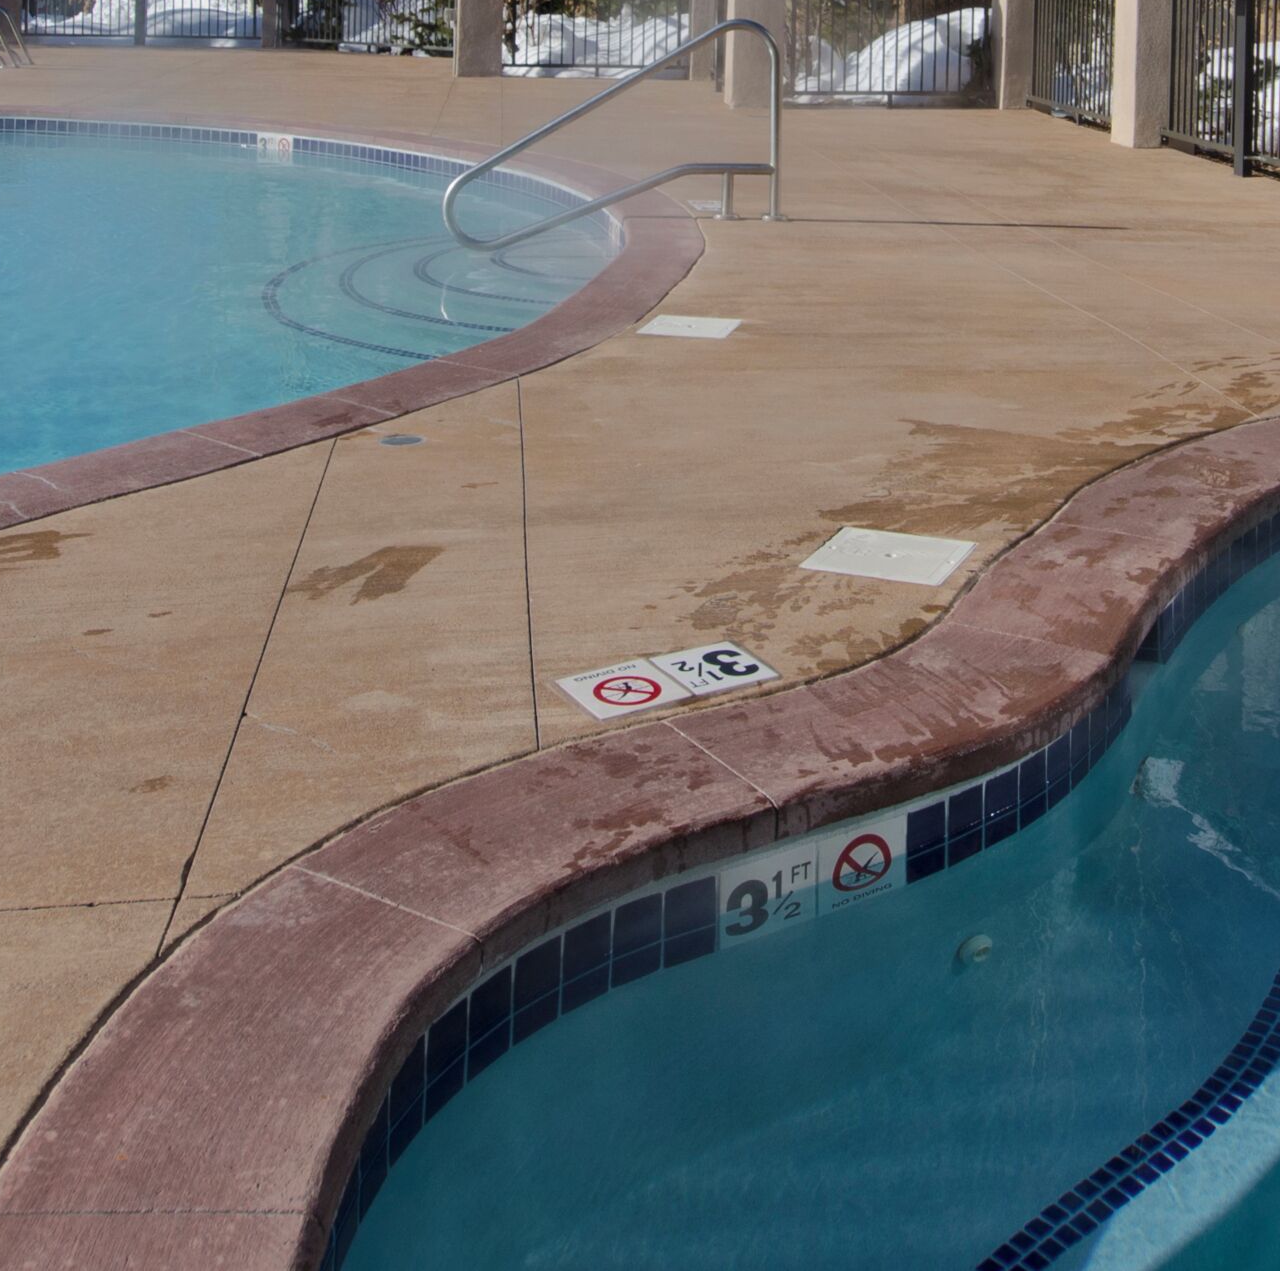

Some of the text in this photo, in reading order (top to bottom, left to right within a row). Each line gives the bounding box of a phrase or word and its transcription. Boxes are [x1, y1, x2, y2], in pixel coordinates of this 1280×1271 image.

[573, 663, 636, 682] NO DIVING
[702, 649, 760, 676] 3
[690, 679, 710, 688] FT
[725, 879, 769, 936] 3
[791, 861, 812, 884] FT
[831, 883, 892, 909] NO DIVING
